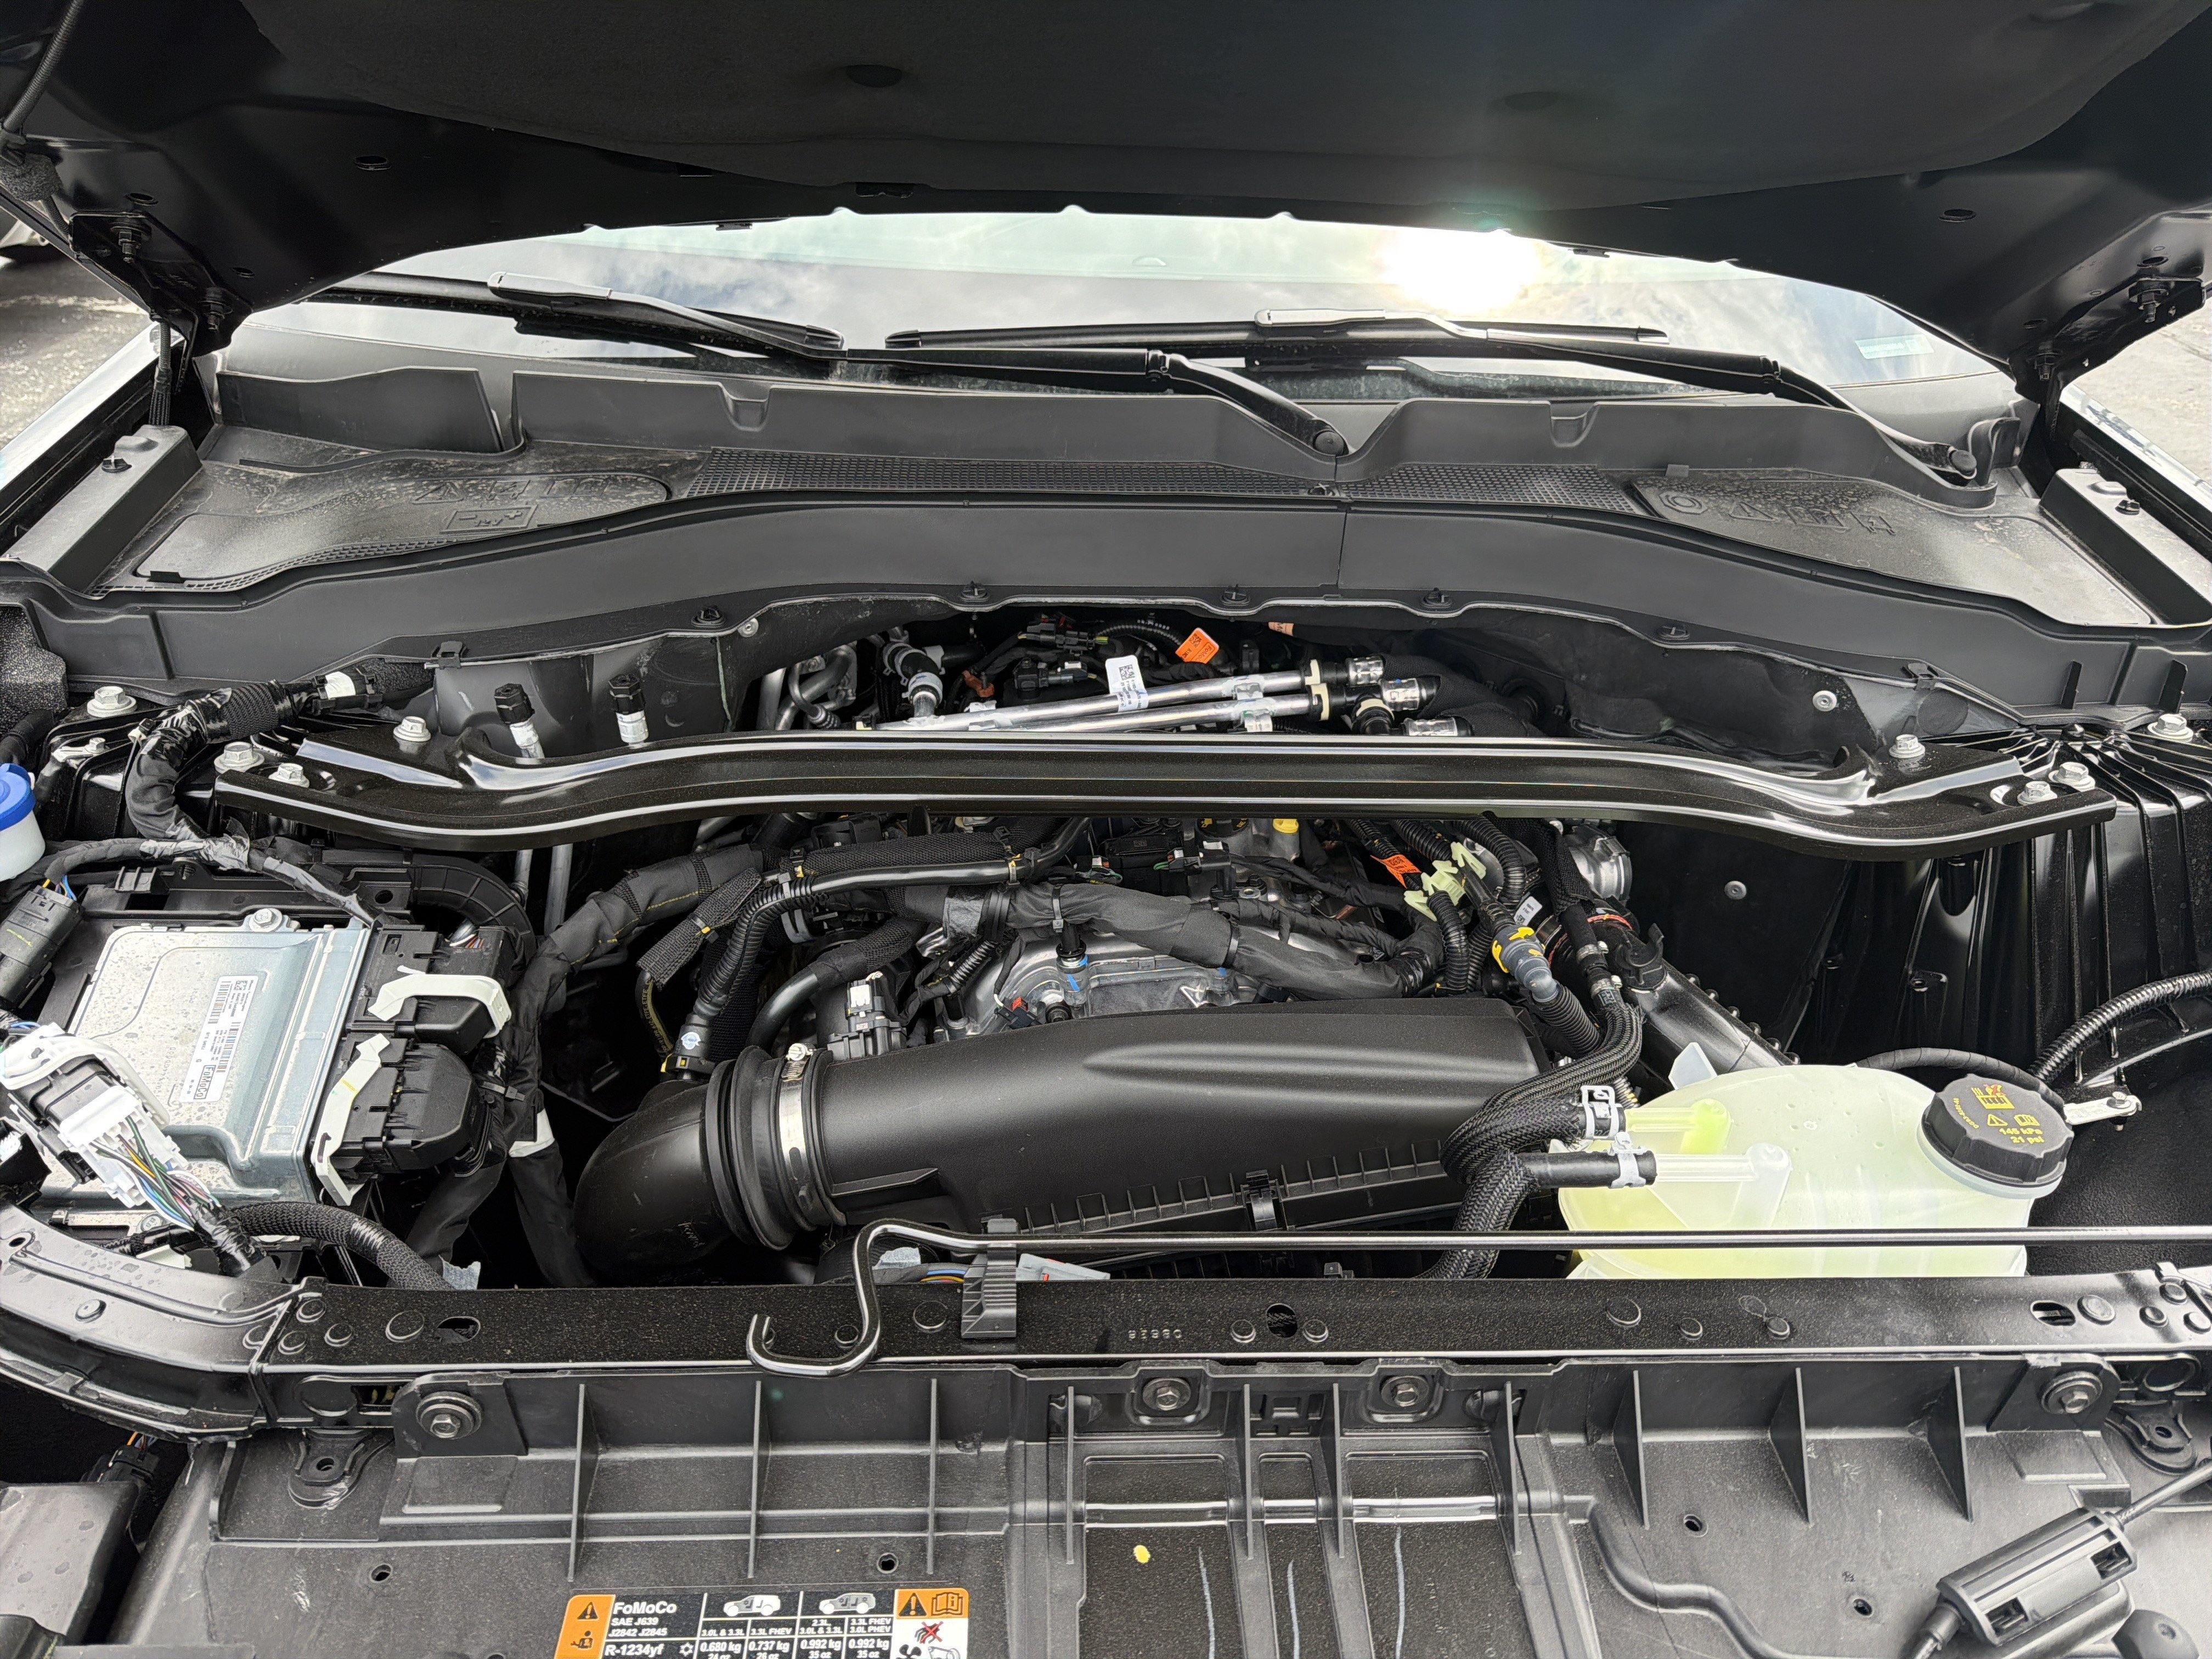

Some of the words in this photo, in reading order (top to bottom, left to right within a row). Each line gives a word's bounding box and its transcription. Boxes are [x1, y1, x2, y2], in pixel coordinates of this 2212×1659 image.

[196, 1066, 213, 1097] FoMoCo
[2027, 1136, 2045, 1144] psi
[613, 1601, 677, 1615] FoMoCo
[611, 1617, 634, 1626] SAE
[634, 1617, 659, 1626] J639
[608, 1628, 637, 1637] J2842
[638, 1628, 668, 1636] J2845
[727, 1628, 745, 1636] 3.3L
[700, 1641, 727, 1652] 0.680
[728, 1641, 742, 1654] kg
[748, 1640, 775, 1651] 0.737
[776, 1640, 790, 1652] kg
[800, 1639, 827, 1649] 0.992
[828, 1639, 842, 1651] kg
[849, 1638, 875, 1649] 0.992
[876, 1638, 890, 1650] kg
[605, 1643, 665, 1658] R-1234yf
[808, 1650, 820, 1658] 35
[856, 1650, 868, 1658] 35
